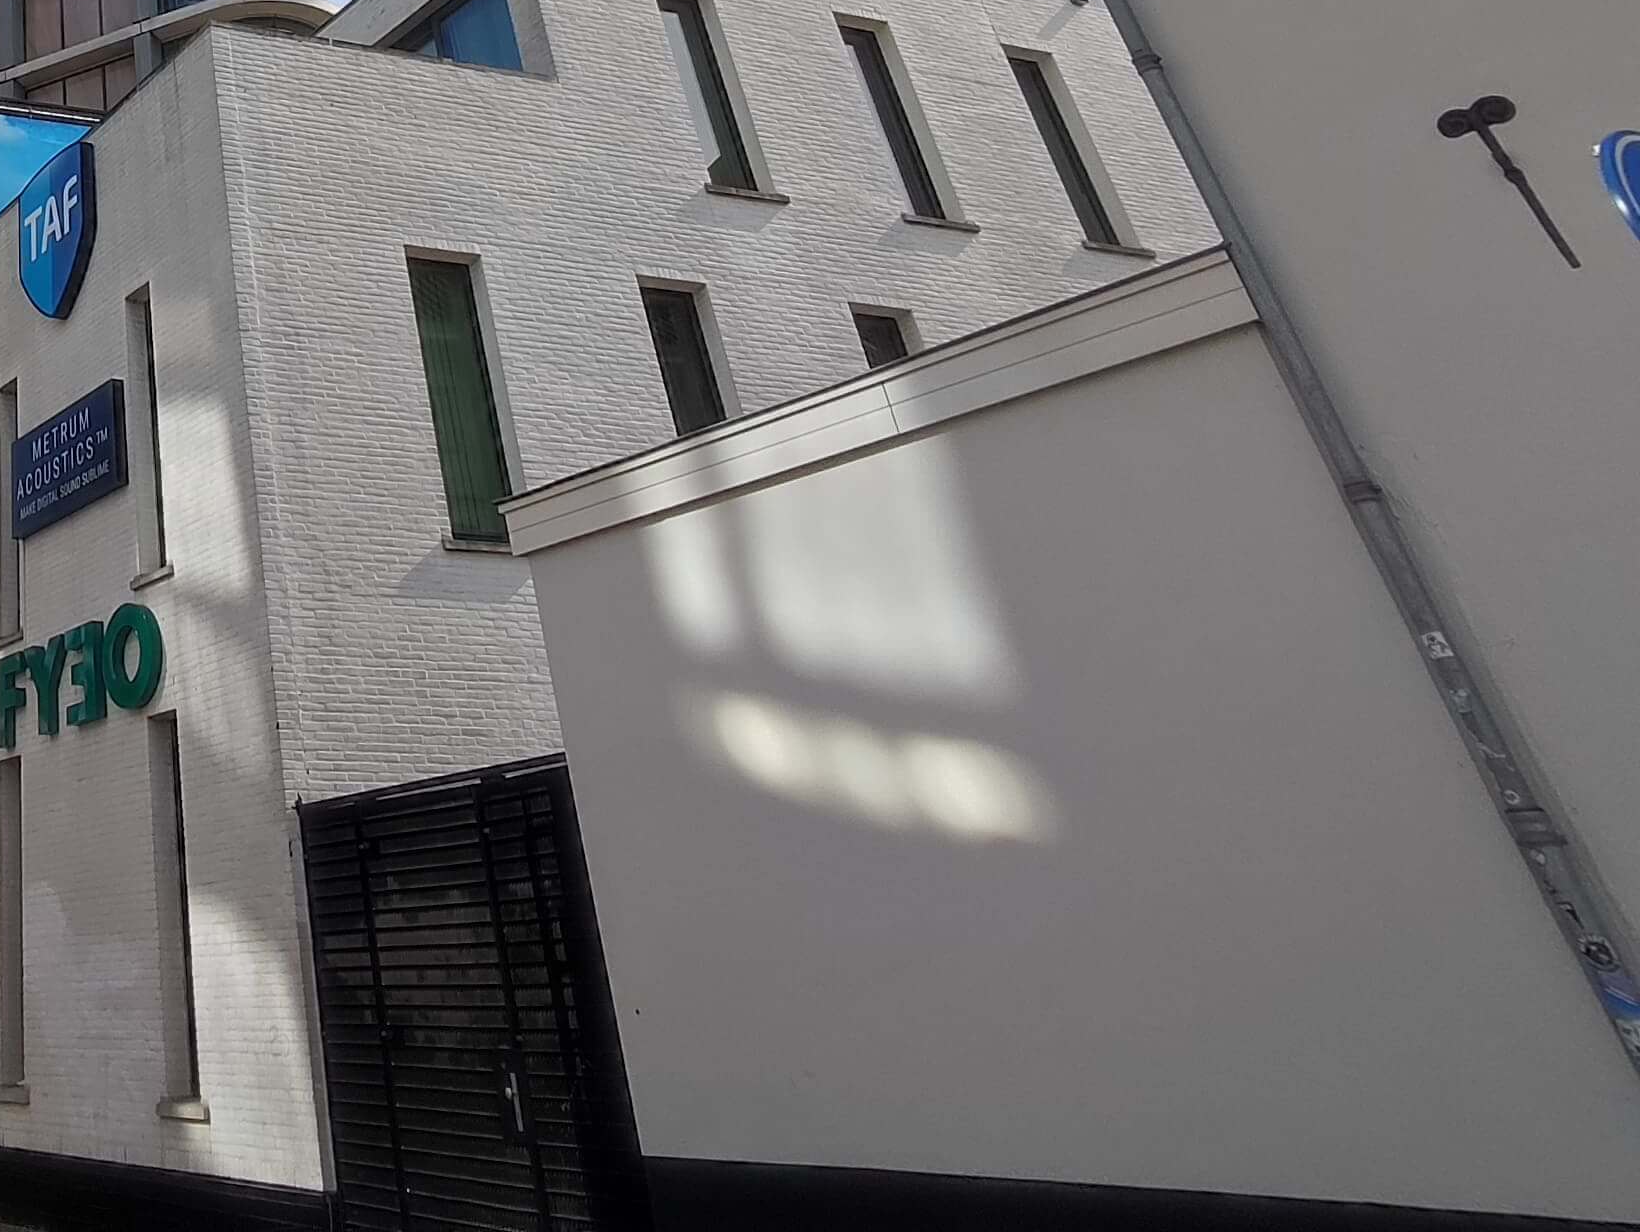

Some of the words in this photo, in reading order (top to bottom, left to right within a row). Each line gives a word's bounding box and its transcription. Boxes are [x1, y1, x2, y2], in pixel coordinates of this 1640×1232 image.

[23, 174, 78, 262] TAF
[32, 406, 90, 462] METRUM
[19, 502, 36, 521] MAKE
[37, 490, 59, 511] DIGITAL
[59, 475, 81, 498] SOUND
[82, 459, 110, 486] SUBLIME
